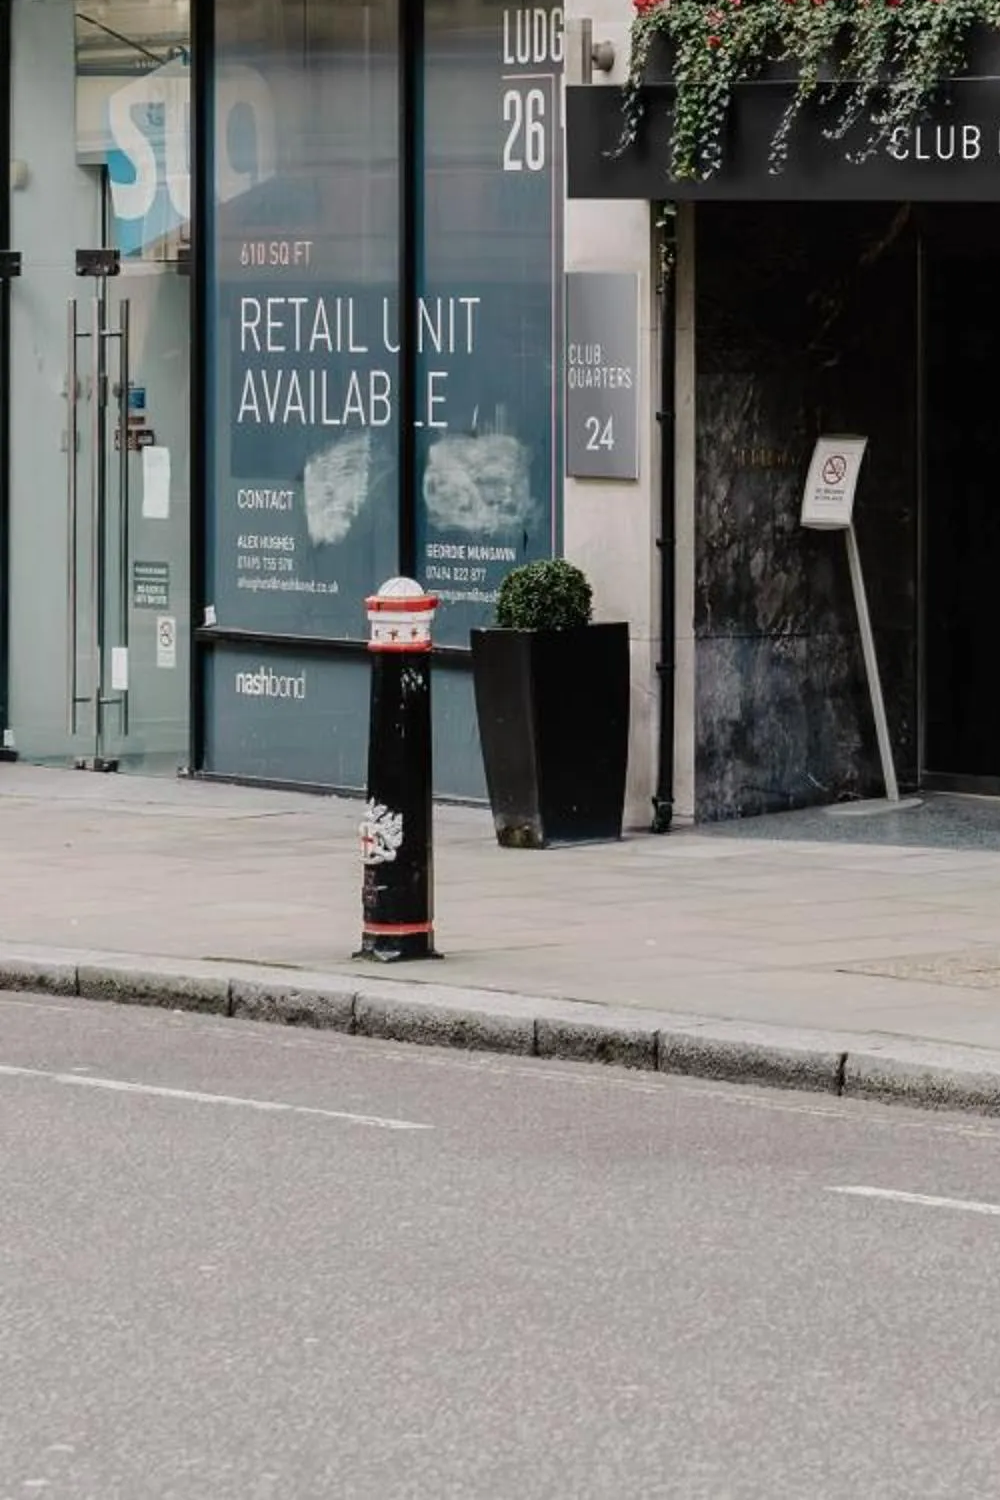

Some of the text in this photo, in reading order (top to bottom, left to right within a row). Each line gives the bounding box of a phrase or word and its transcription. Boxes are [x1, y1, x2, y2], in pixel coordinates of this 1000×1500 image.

[503, 88, 545, 171] 26
[890, 124, 982, 160] CLUB
[240, 241, 314, 266] 610 SQ FT
[240, 297, 369, 352] RETAIL
[568, 344, 602, 365] CLUB
[568, 367, 633, 389] QUARTERS
[237, 369, 449, 428] AVAILABE
[584, 414, 615, 451] 24
[237, 489, 296, 511] CONTACT
[236, 665, 306, 699] nashbond
